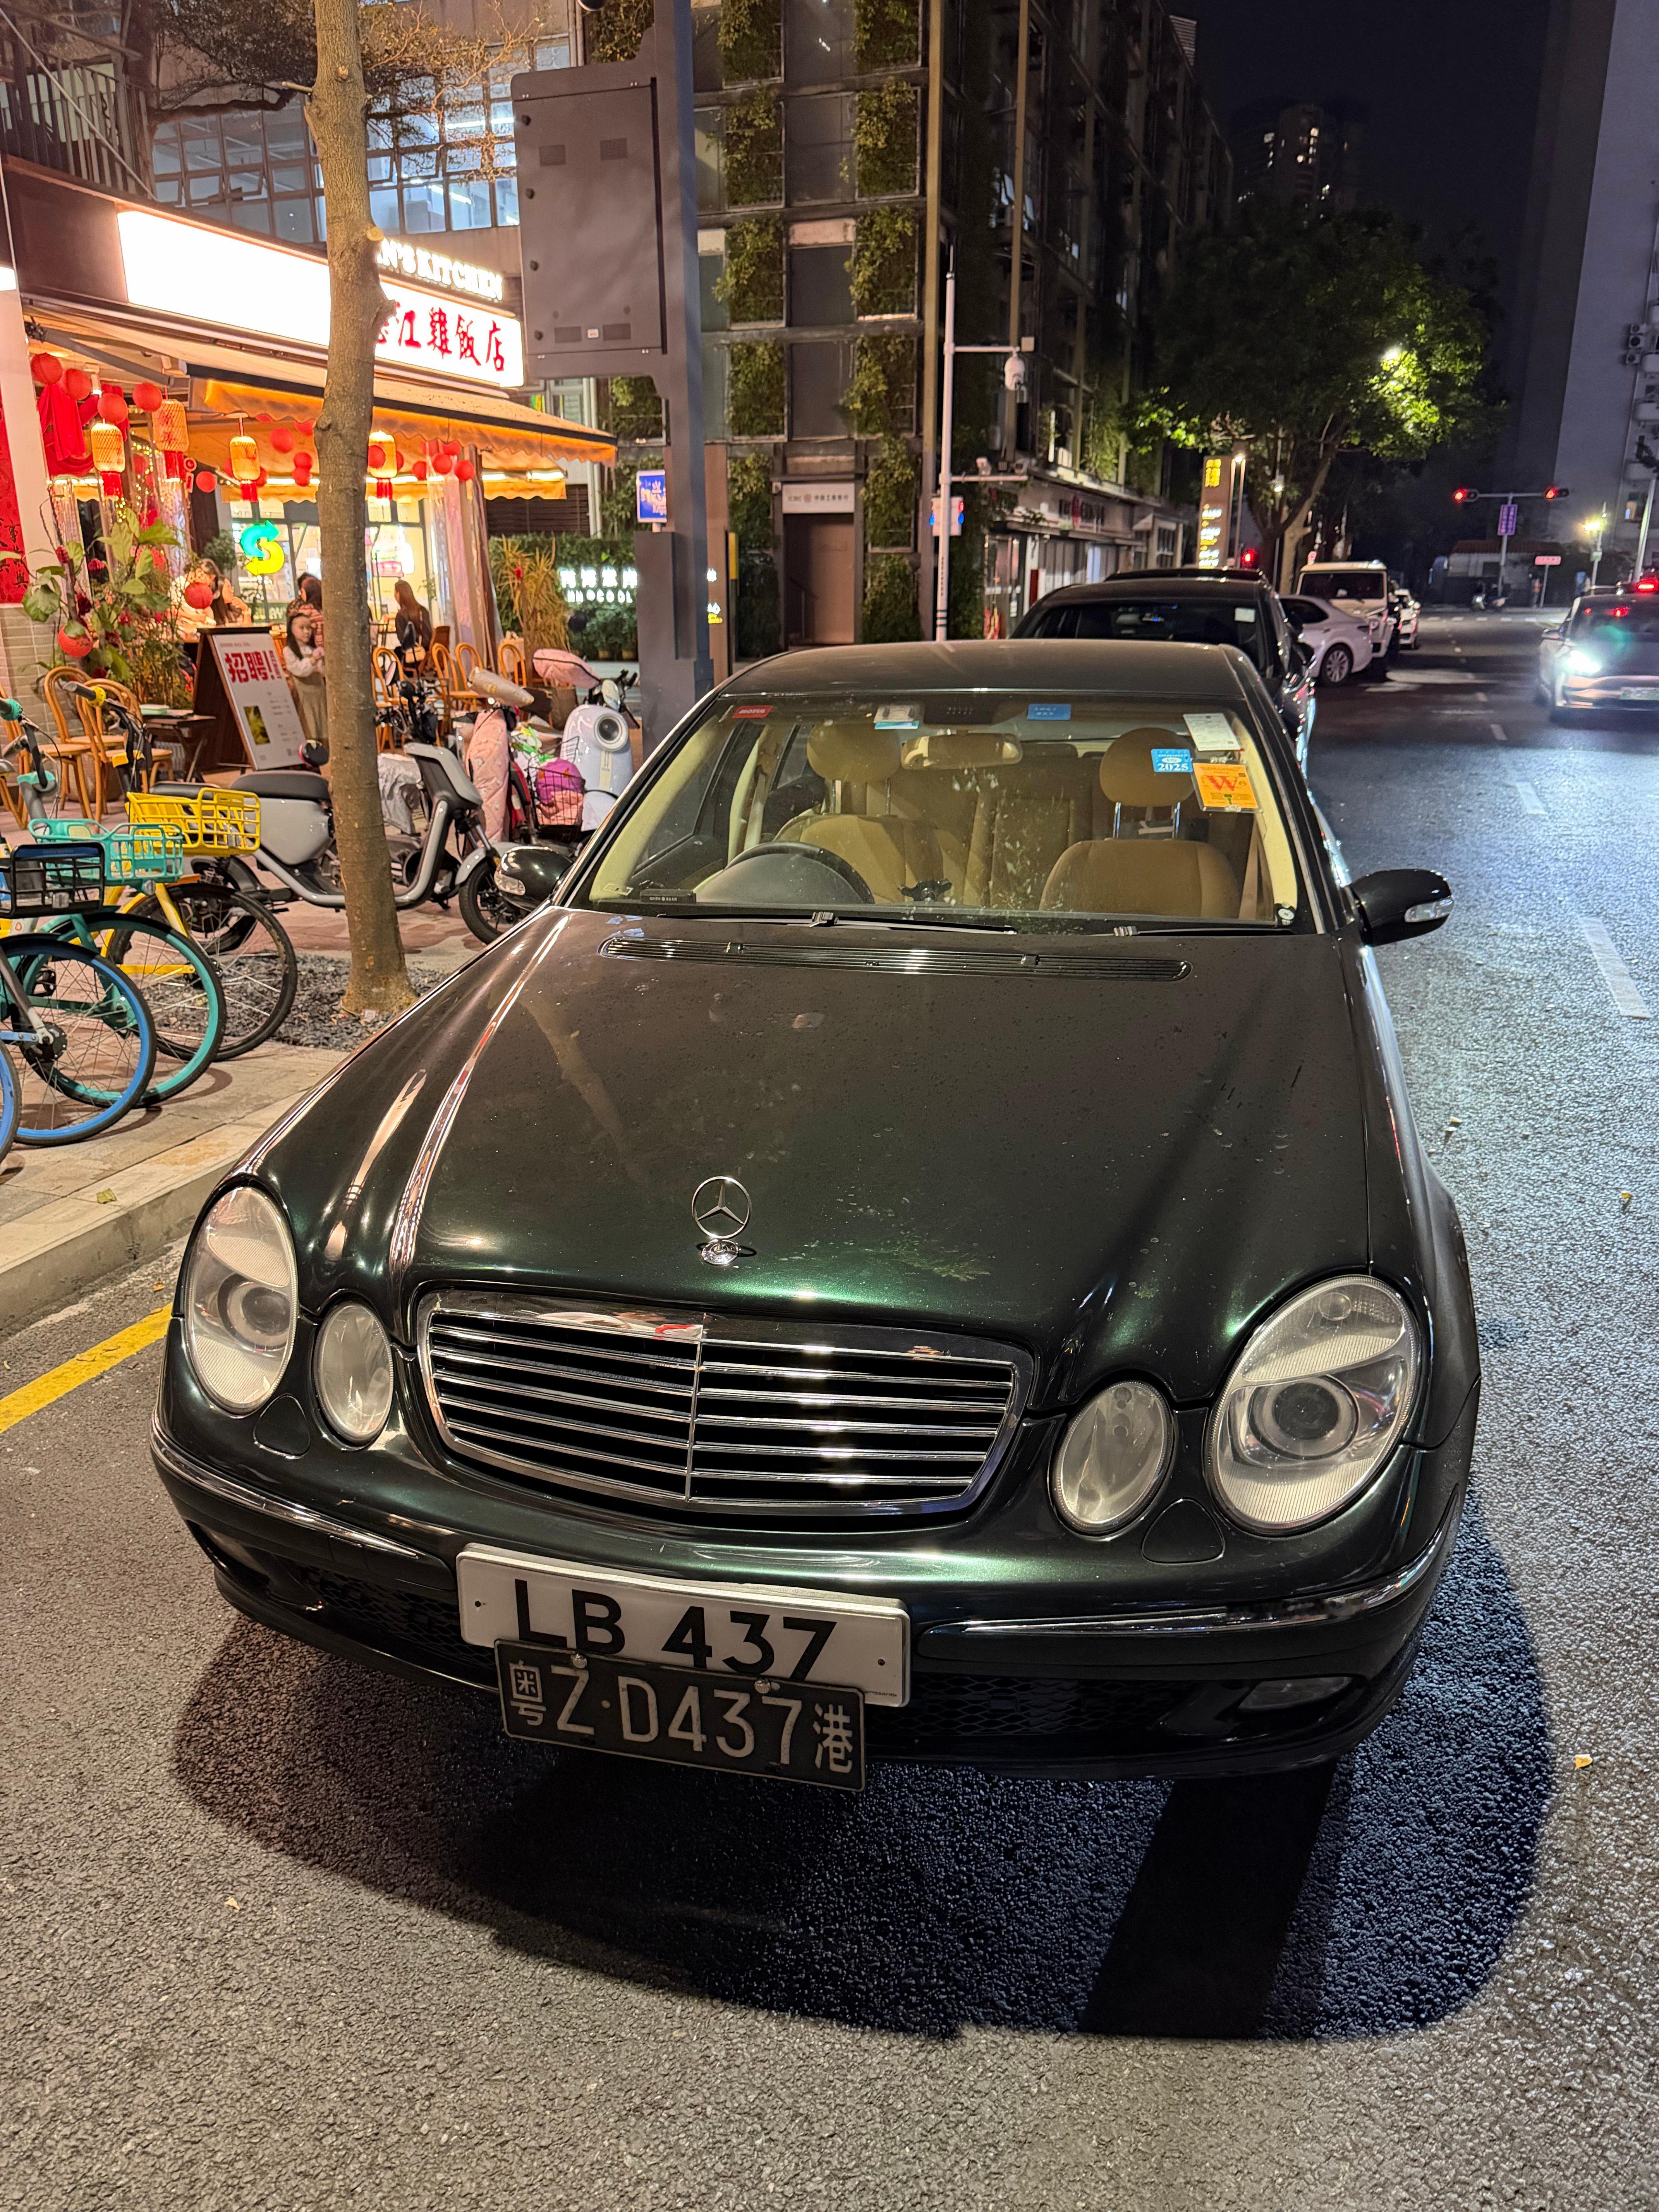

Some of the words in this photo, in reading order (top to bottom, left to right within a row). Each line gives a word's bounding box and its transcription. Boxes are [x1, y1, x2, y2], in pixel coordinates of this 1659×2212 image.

[377, 237, 416, 273] N'S
[416, 248, 503, 301] KITCHEN
[377, 301, 505, 371] 江雞飯店
[1157, 763, 1188, 771] 2025
[1205, 775, 1241, 791] W
[514, 1579, 625, 1655] LB
[661, 1606, 837, 1681] 437
